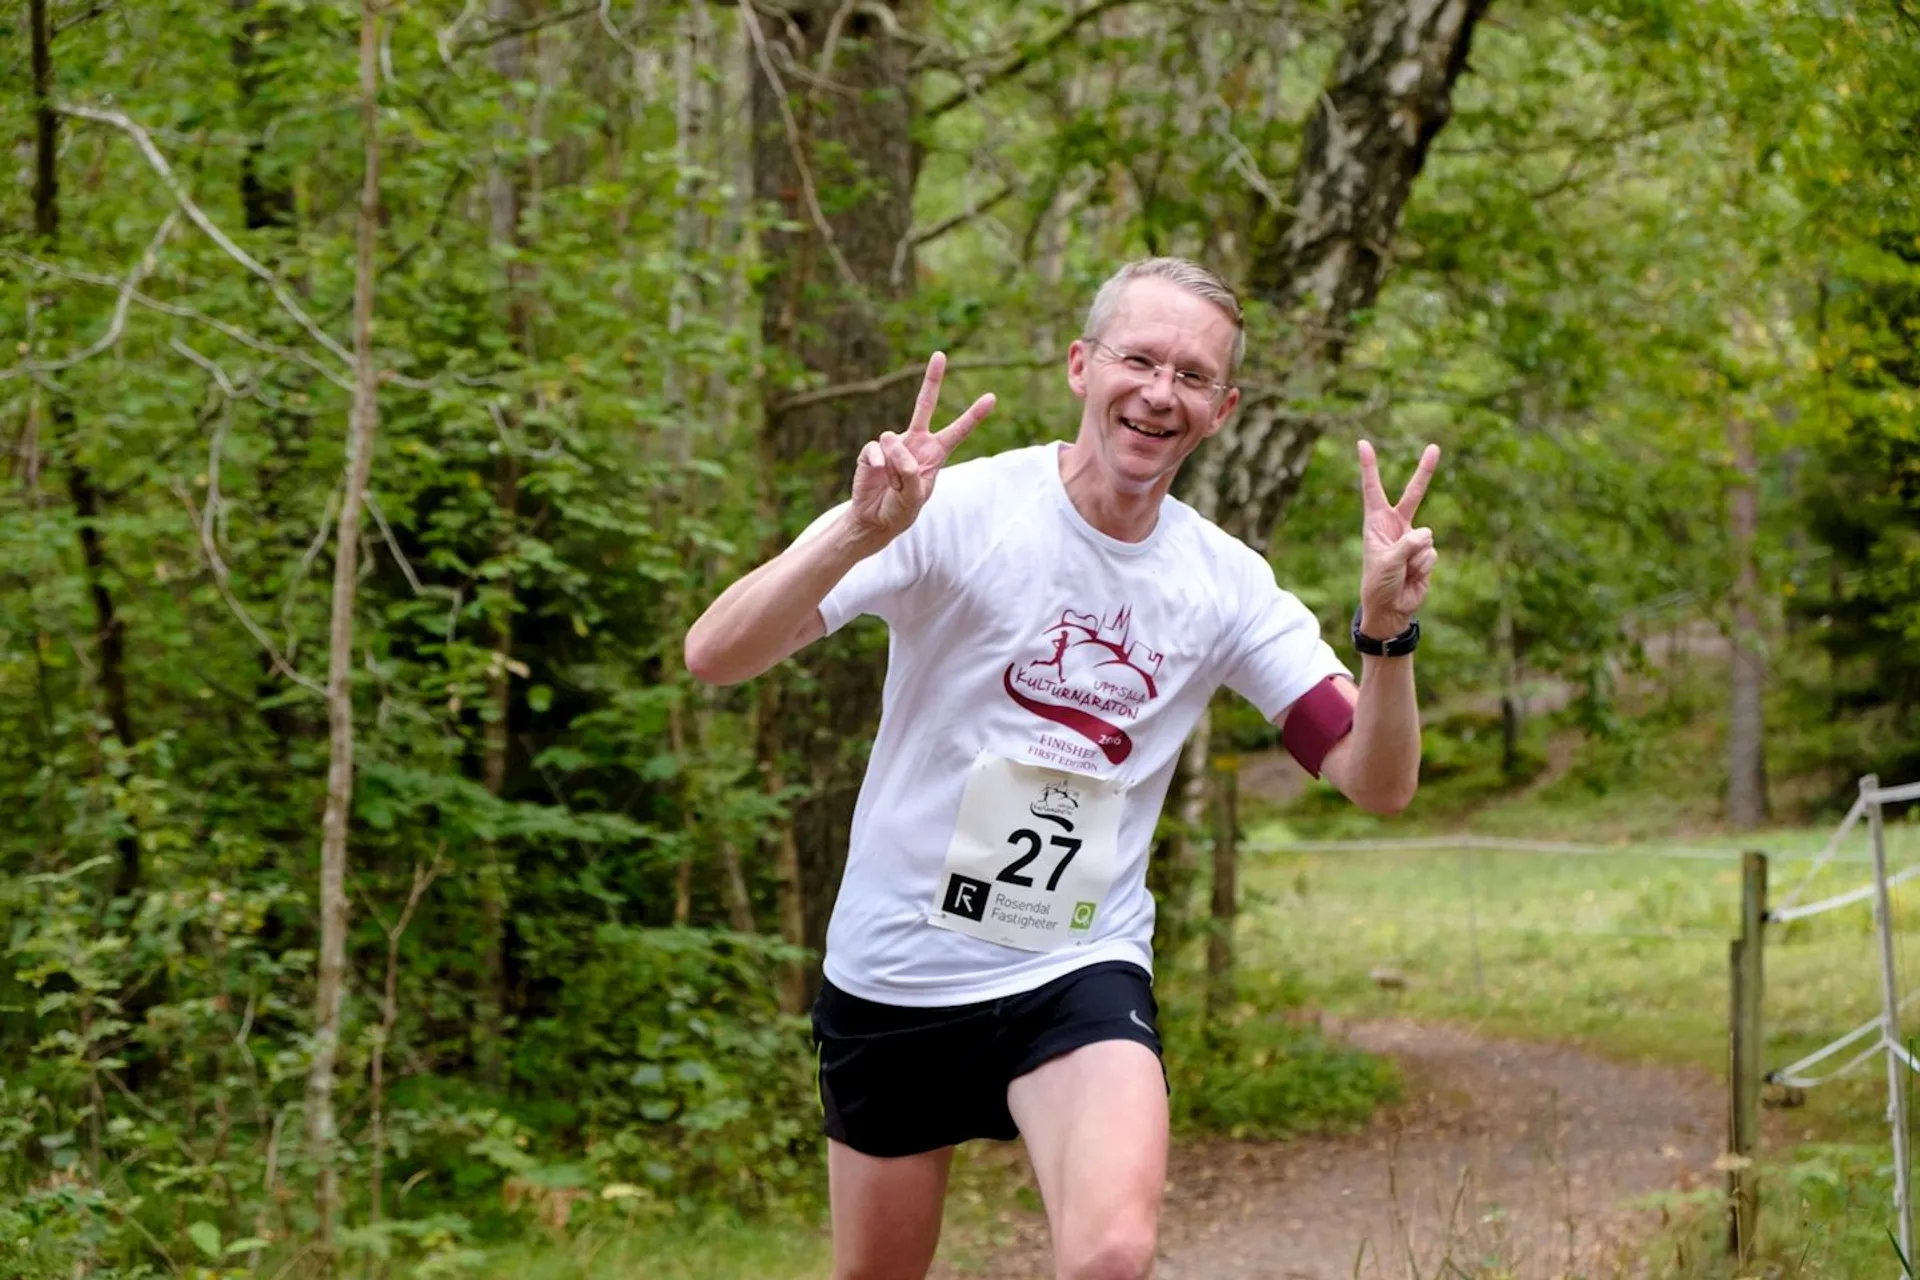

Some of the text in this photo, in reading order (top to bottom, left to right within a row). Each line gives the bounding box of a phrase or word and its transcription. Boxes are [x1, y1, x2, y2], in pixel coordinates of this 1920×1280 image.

[1015, 667, 1139, 720] KULTURMARATON
[1027, 745, 1057, 761] FIRST
[995, 828, 1082, 892] 27
[995, 893, 1051, 915] Rosendal
[991, 907, 1059, 930] Fastigheter
